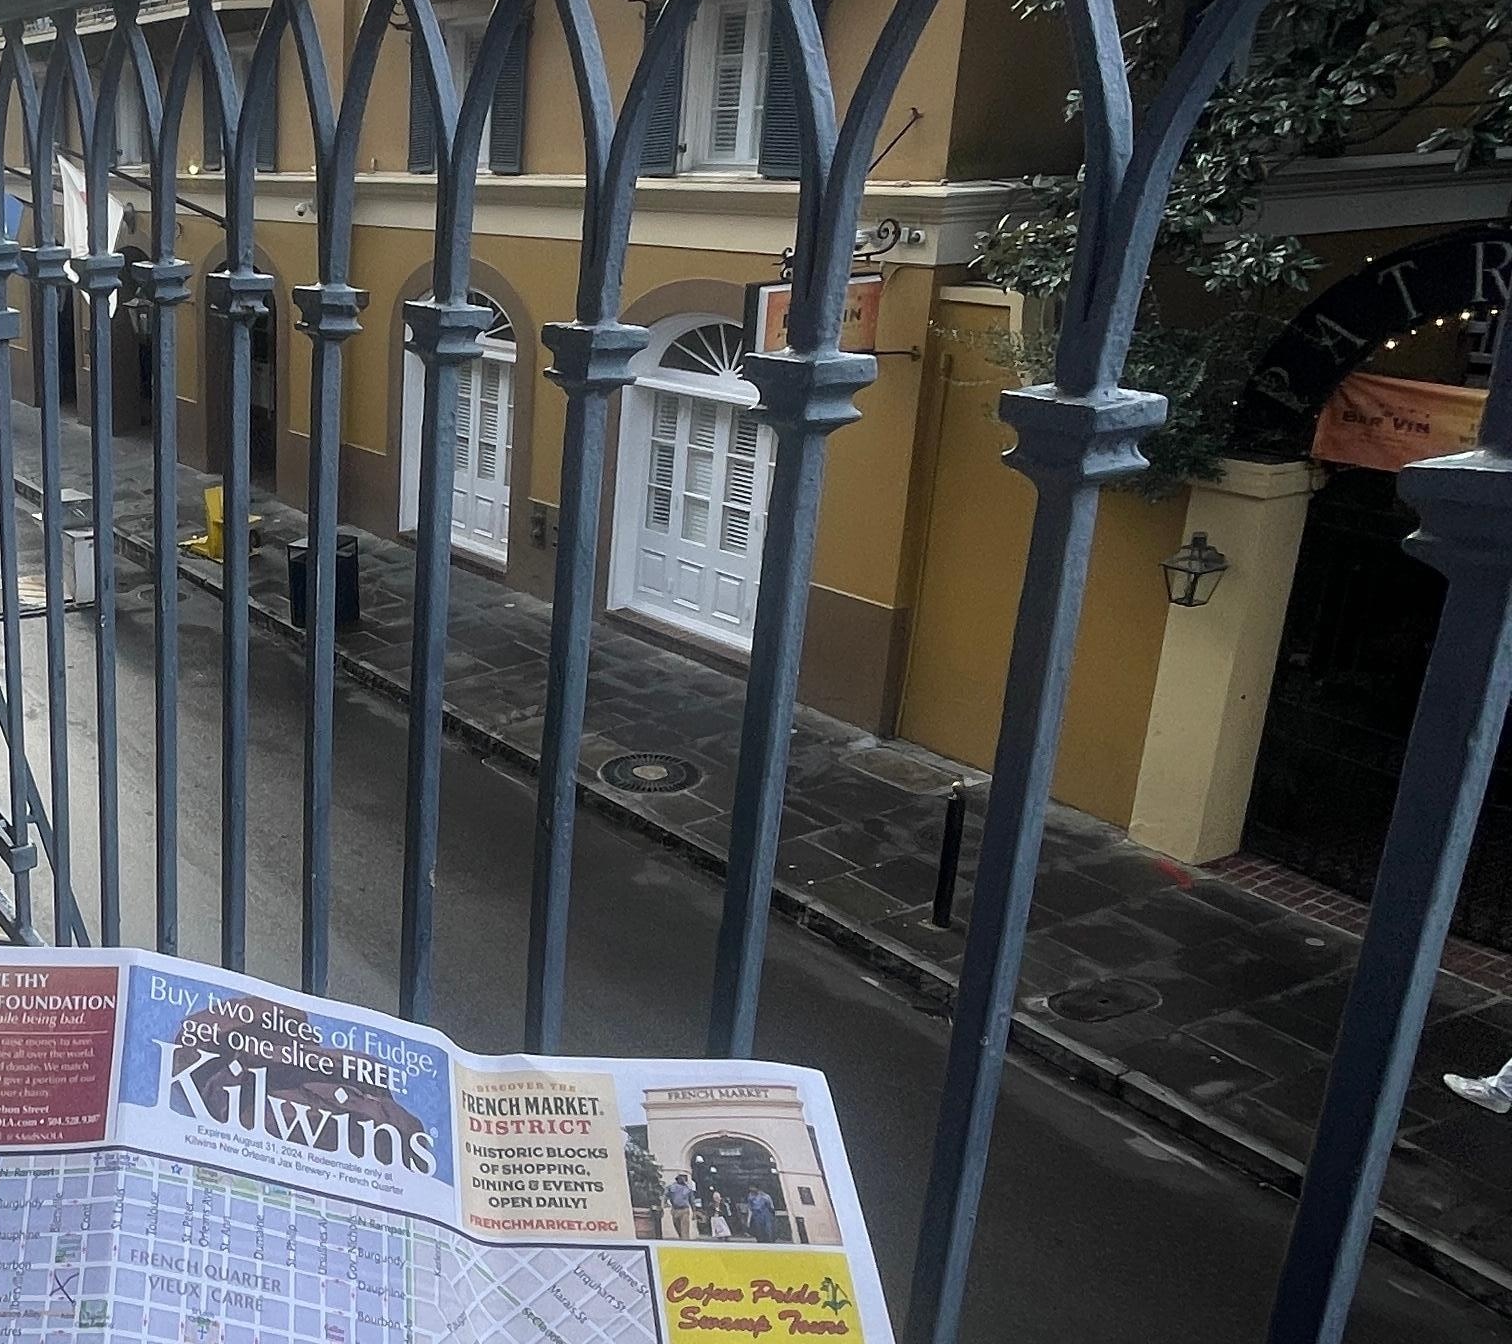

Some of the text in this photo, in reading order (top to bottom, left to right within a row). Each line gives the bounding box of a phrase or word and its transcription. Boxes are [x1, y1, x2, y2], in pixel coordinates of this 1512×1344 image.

[1392, 417, 1430, 433] VIN
[15, 973, 50, 988] THY
[21, 1011, 56, 1028] being
[60, 1011, 86, 1025] bad.
[150, 976, 438, 1080] Buy two slices of Fudge,
[181, 1019, 408, 1095] get one slice FREE!
[462, 1090, 521, 1117] FRENCH
[667, 1088, 771, 1102] FRENCH MARKET
[151, 1038, 437, 1177] Kilwins
[468, 1118, 592, 1136] DISTRICT
[473, 1143, 544, 1159] HISTORIC
[547, 1145, 609, 1159] BLOCKS
[480, 1161, 501, 1175] OF
[472, 1177, 526, 1192] DINING
[543, 1180, 604, 1193] EVENTS
[488, 1195, 587, 1210] OPEN DAILY!
[470, 1215, 619, 1232] FRENCHMARKET.ORG
[130, 1248, 281, 1293] FRENCH QUARTER
[148, 1276, 201, 1298] VIEUX
[666, 1276, 821, 1307] Cajun Pride
[678, 1306, 850, 1338] Swamp Tours
